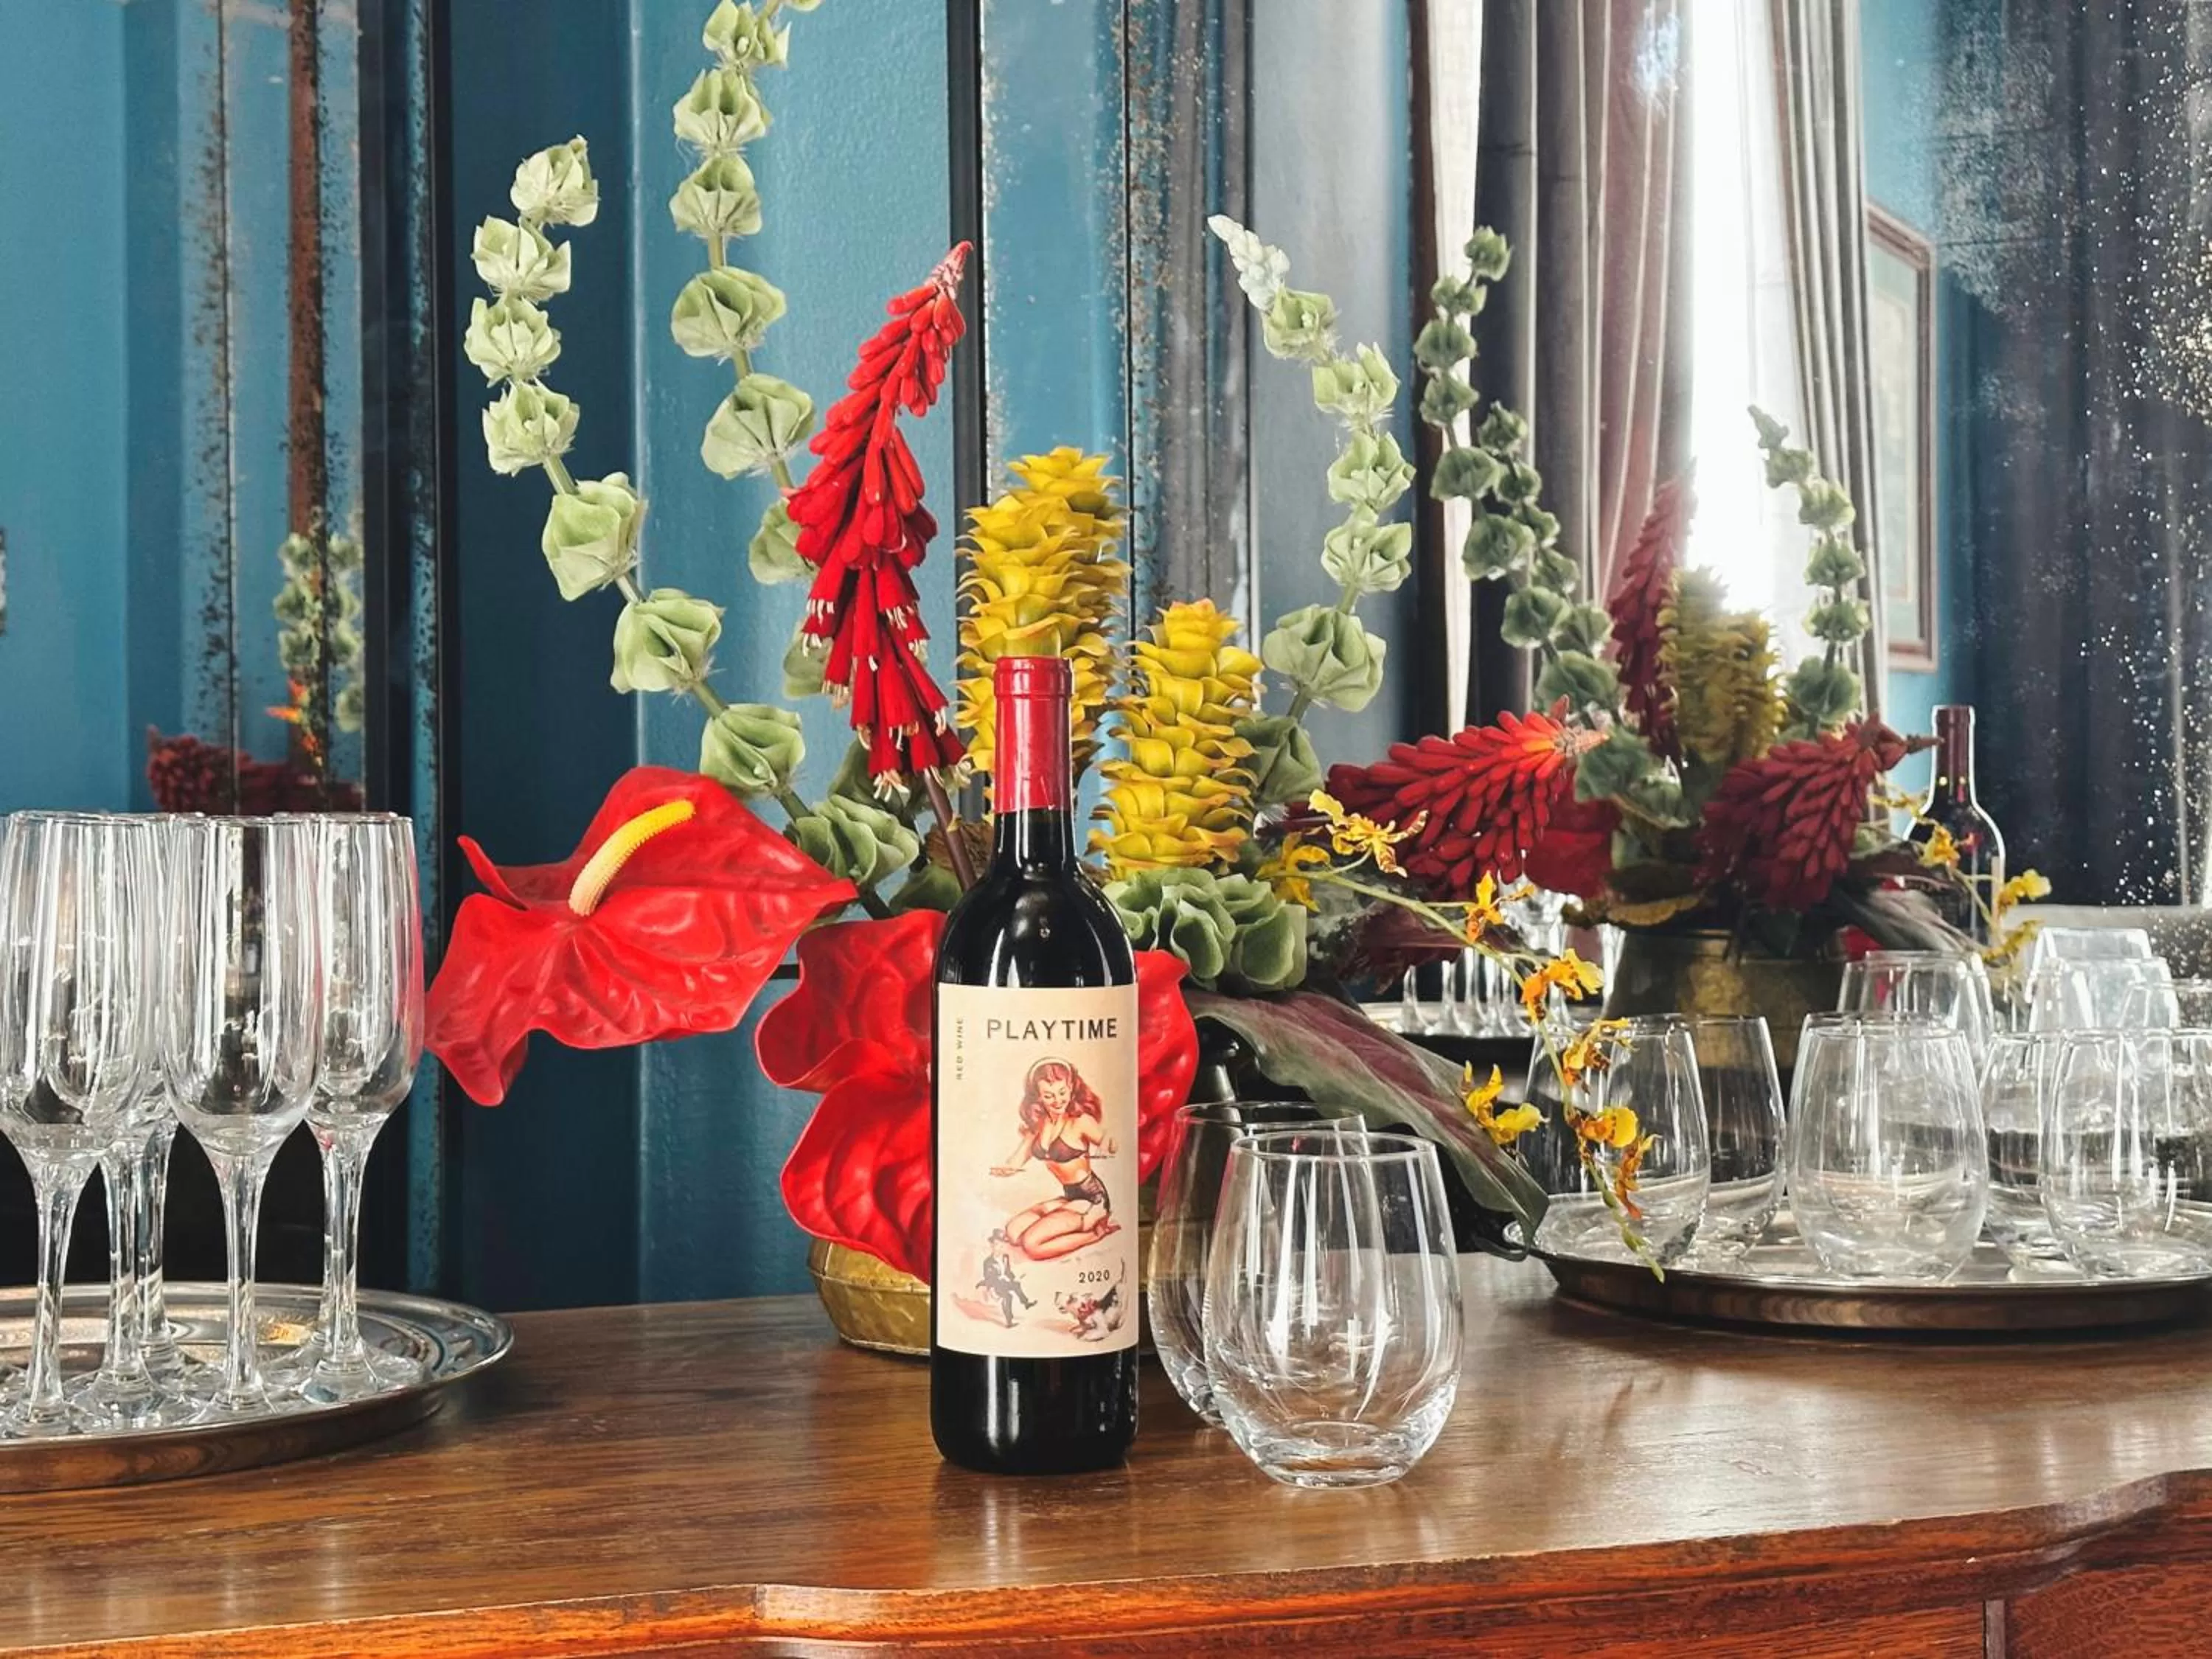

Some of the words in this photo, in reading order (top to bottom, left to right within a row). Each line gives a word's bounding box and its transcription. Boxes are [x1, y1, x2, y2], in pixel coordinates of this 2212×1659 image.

[956, 1018, 964, 1050] WINE
[987, 1018, 1118, 1040] PLAYTIME
[956, 1055, 964, 1080] RED
[1079, 1269, 1110, 1283] 2020
